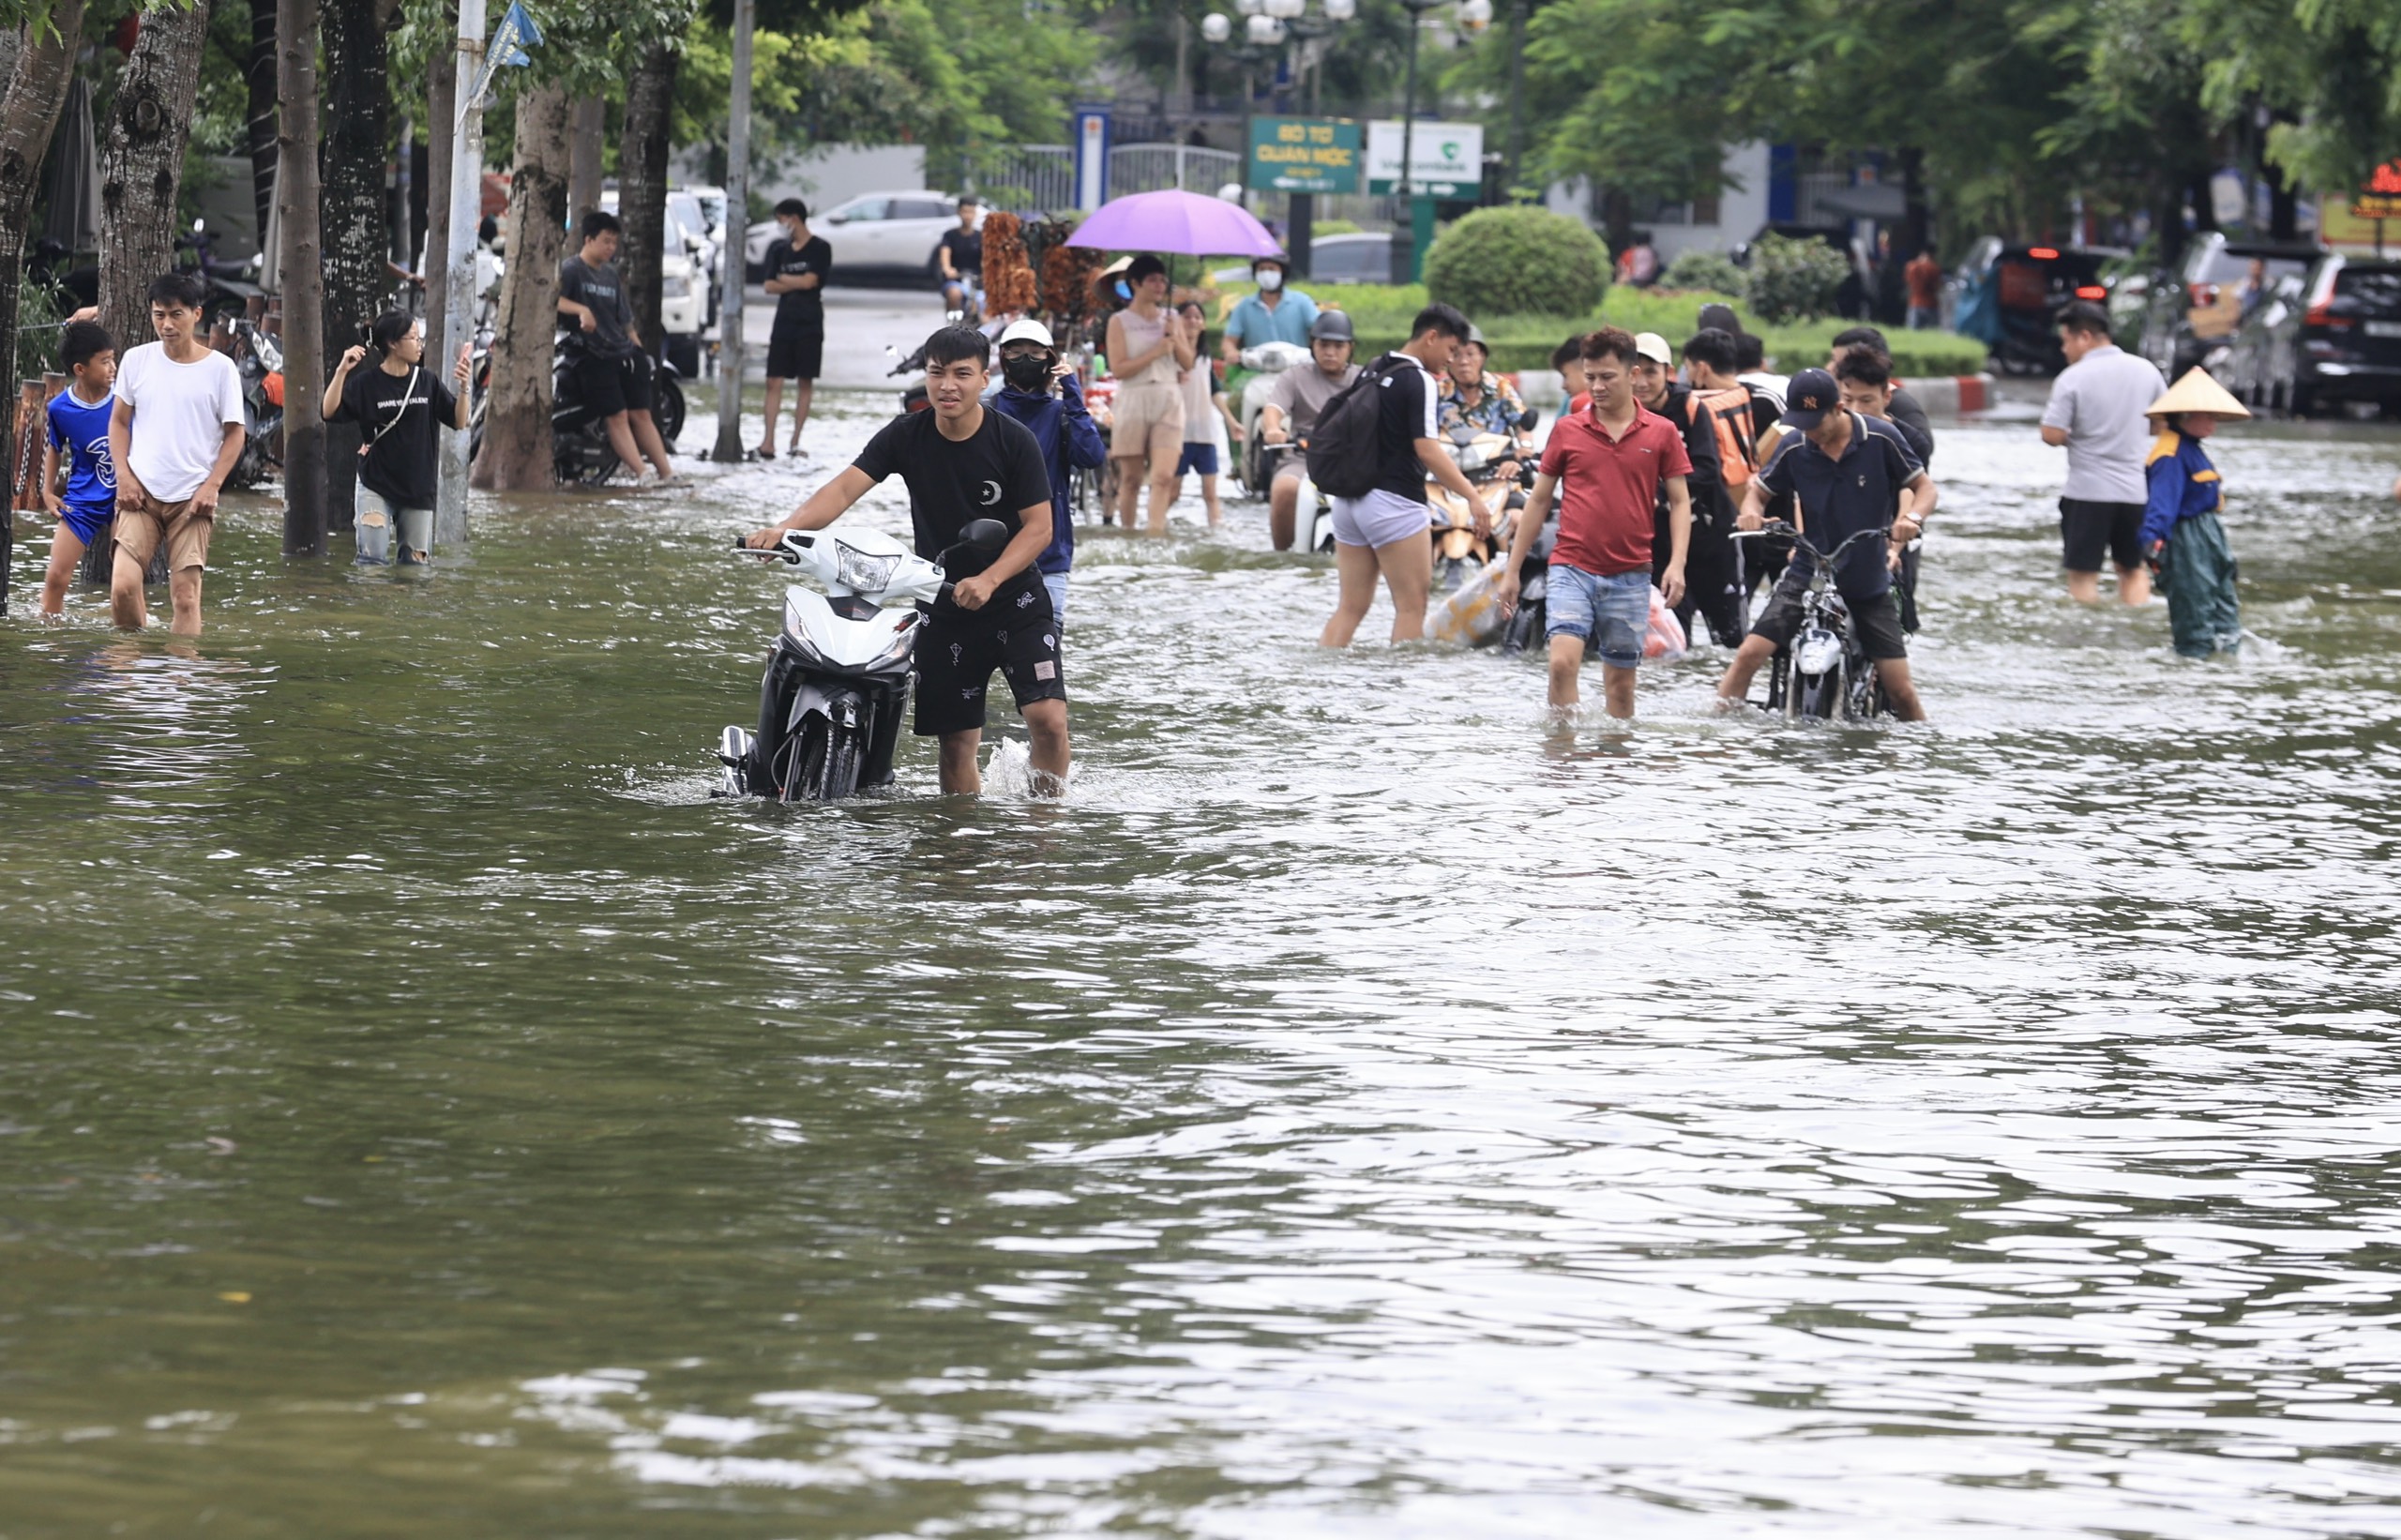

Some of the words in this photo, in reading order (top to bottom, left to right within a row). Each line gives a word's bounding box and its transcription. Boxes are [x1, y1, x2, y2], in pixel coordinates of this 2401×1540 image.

[1381, 159, 1467, 172] Viecombank
[1389, 179, 1427, 195] AM
[377, 399, 397, 409] SHARE
[409, 397, 429, 405] TALENT
